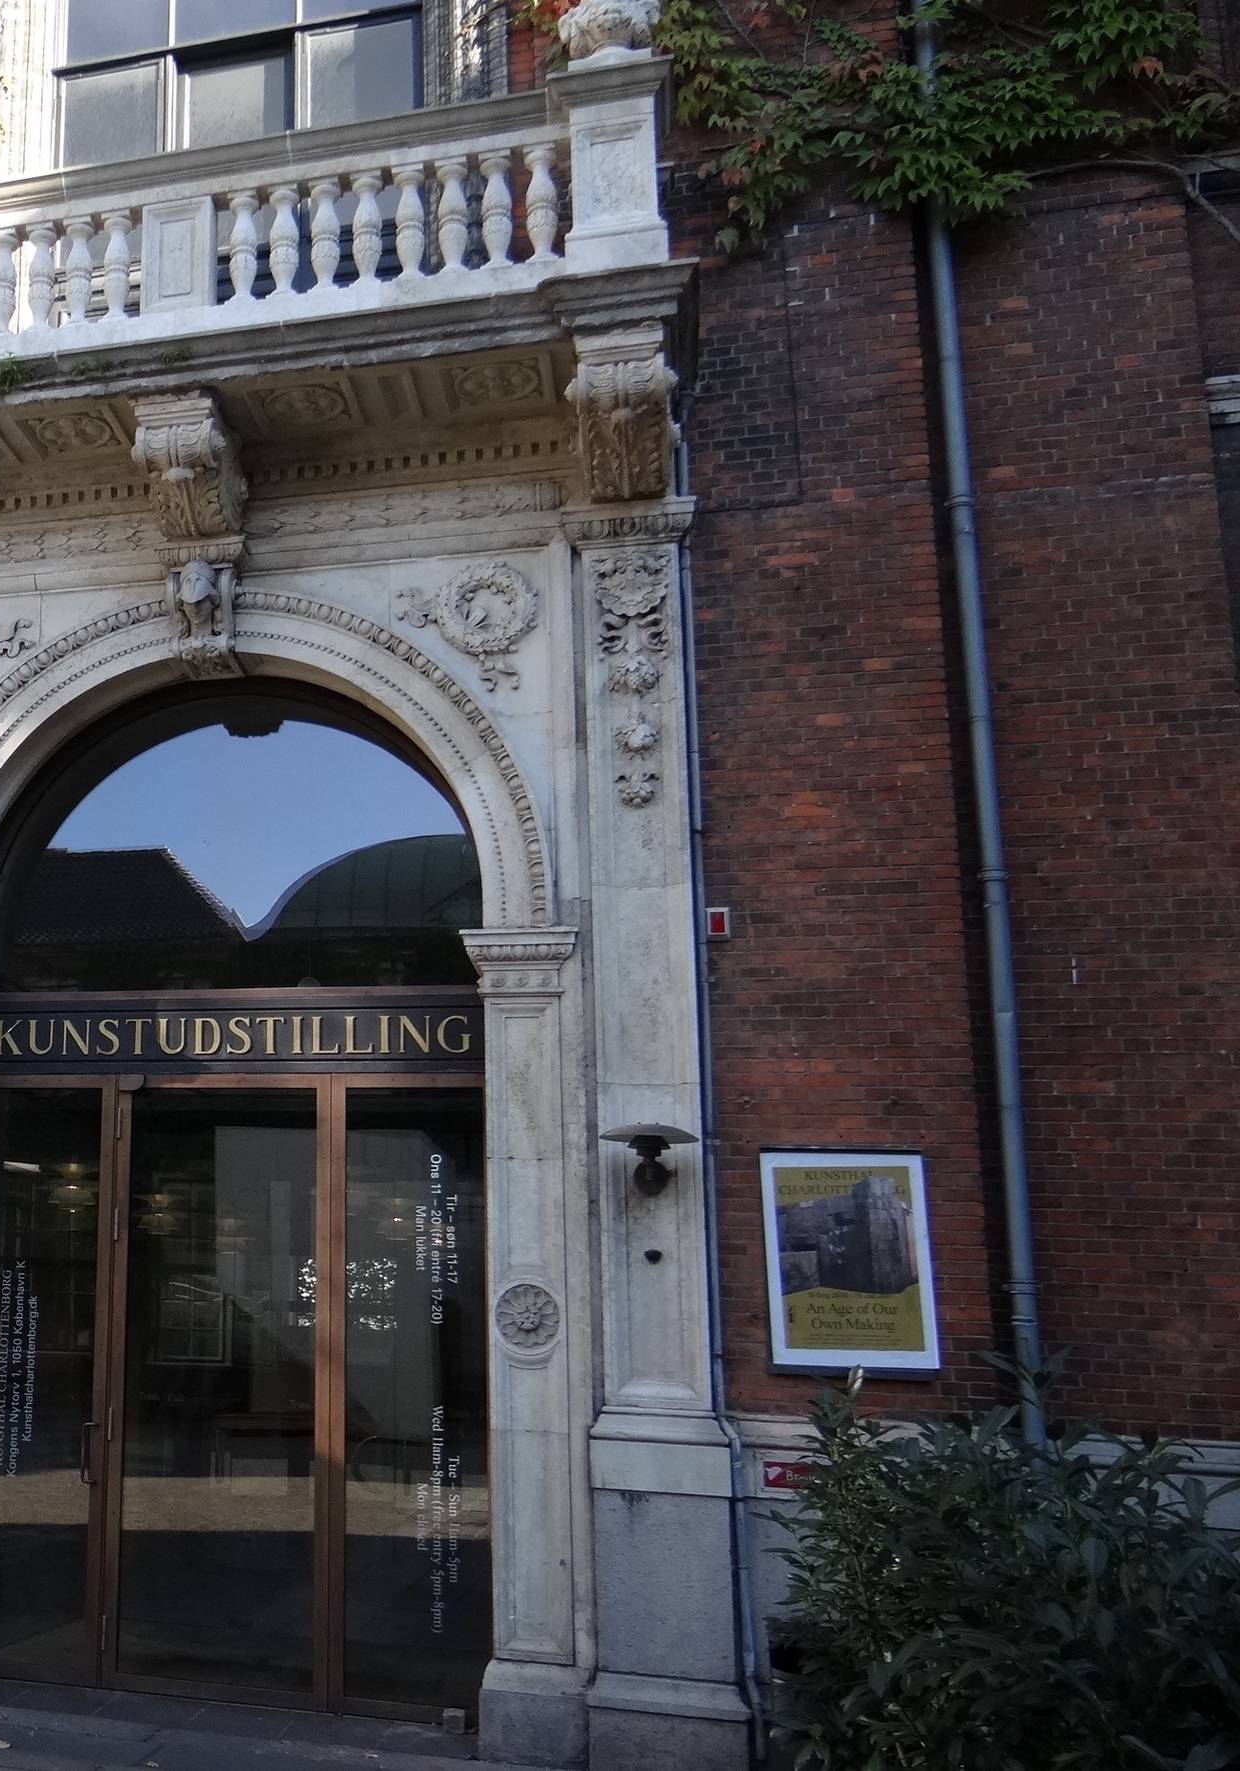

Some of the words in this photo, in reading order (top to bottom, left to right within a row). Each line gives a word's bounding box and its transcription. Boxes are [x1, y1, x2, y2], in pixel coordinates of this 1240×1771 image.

[430, 1154, 441, 1178] Ons
[431, 1184, 441, 1194] 11
[446, 1195, 457, 1211] Tir
[415, 1206, 426, 1231] Man
[431, 1210, 441, 1225] 20
[446, 1226, 456, 1248] søn
[415, 1236, 426, 1271] lukket
[431, 1251, 443, 1282] entré
[447, 1253, 457, 1283] 11-17
[13, 1272, 25, 1334] København
[430, 1288, 442, 1324] 17-20)
[805, 1304, 824, 1314] An
[829, 1304, 854, 1317] Age
[857, 1303, 870, 1315] of
[873, 1304, 899, 1315] Our
[811, 1318, 841, 1330] Own
[846, 1319, 895, 1333] Making
[12, 1338, 23, 1364] 1050
[22, 1296, 39, 1441] Kunsthalcharlottenborg.dk
[9, 1382, 21, 1422] Nytorv
[432, 1406, 443, 1431] Wed
[7, 1427, 20, 1477] Kongens
[430, 1437, 443, 1497] 11am-8pm
[448, 1456, 459, 1478] Tue
[417, 1483, 428, 1509] Mon
[448, 1494, 460, 1517] Sun
[430, 1501, 443, 1529] (free
[430, 1536, 443, 1565] entry
[430, 1569, 443, 1634] 5pm-8pm)
